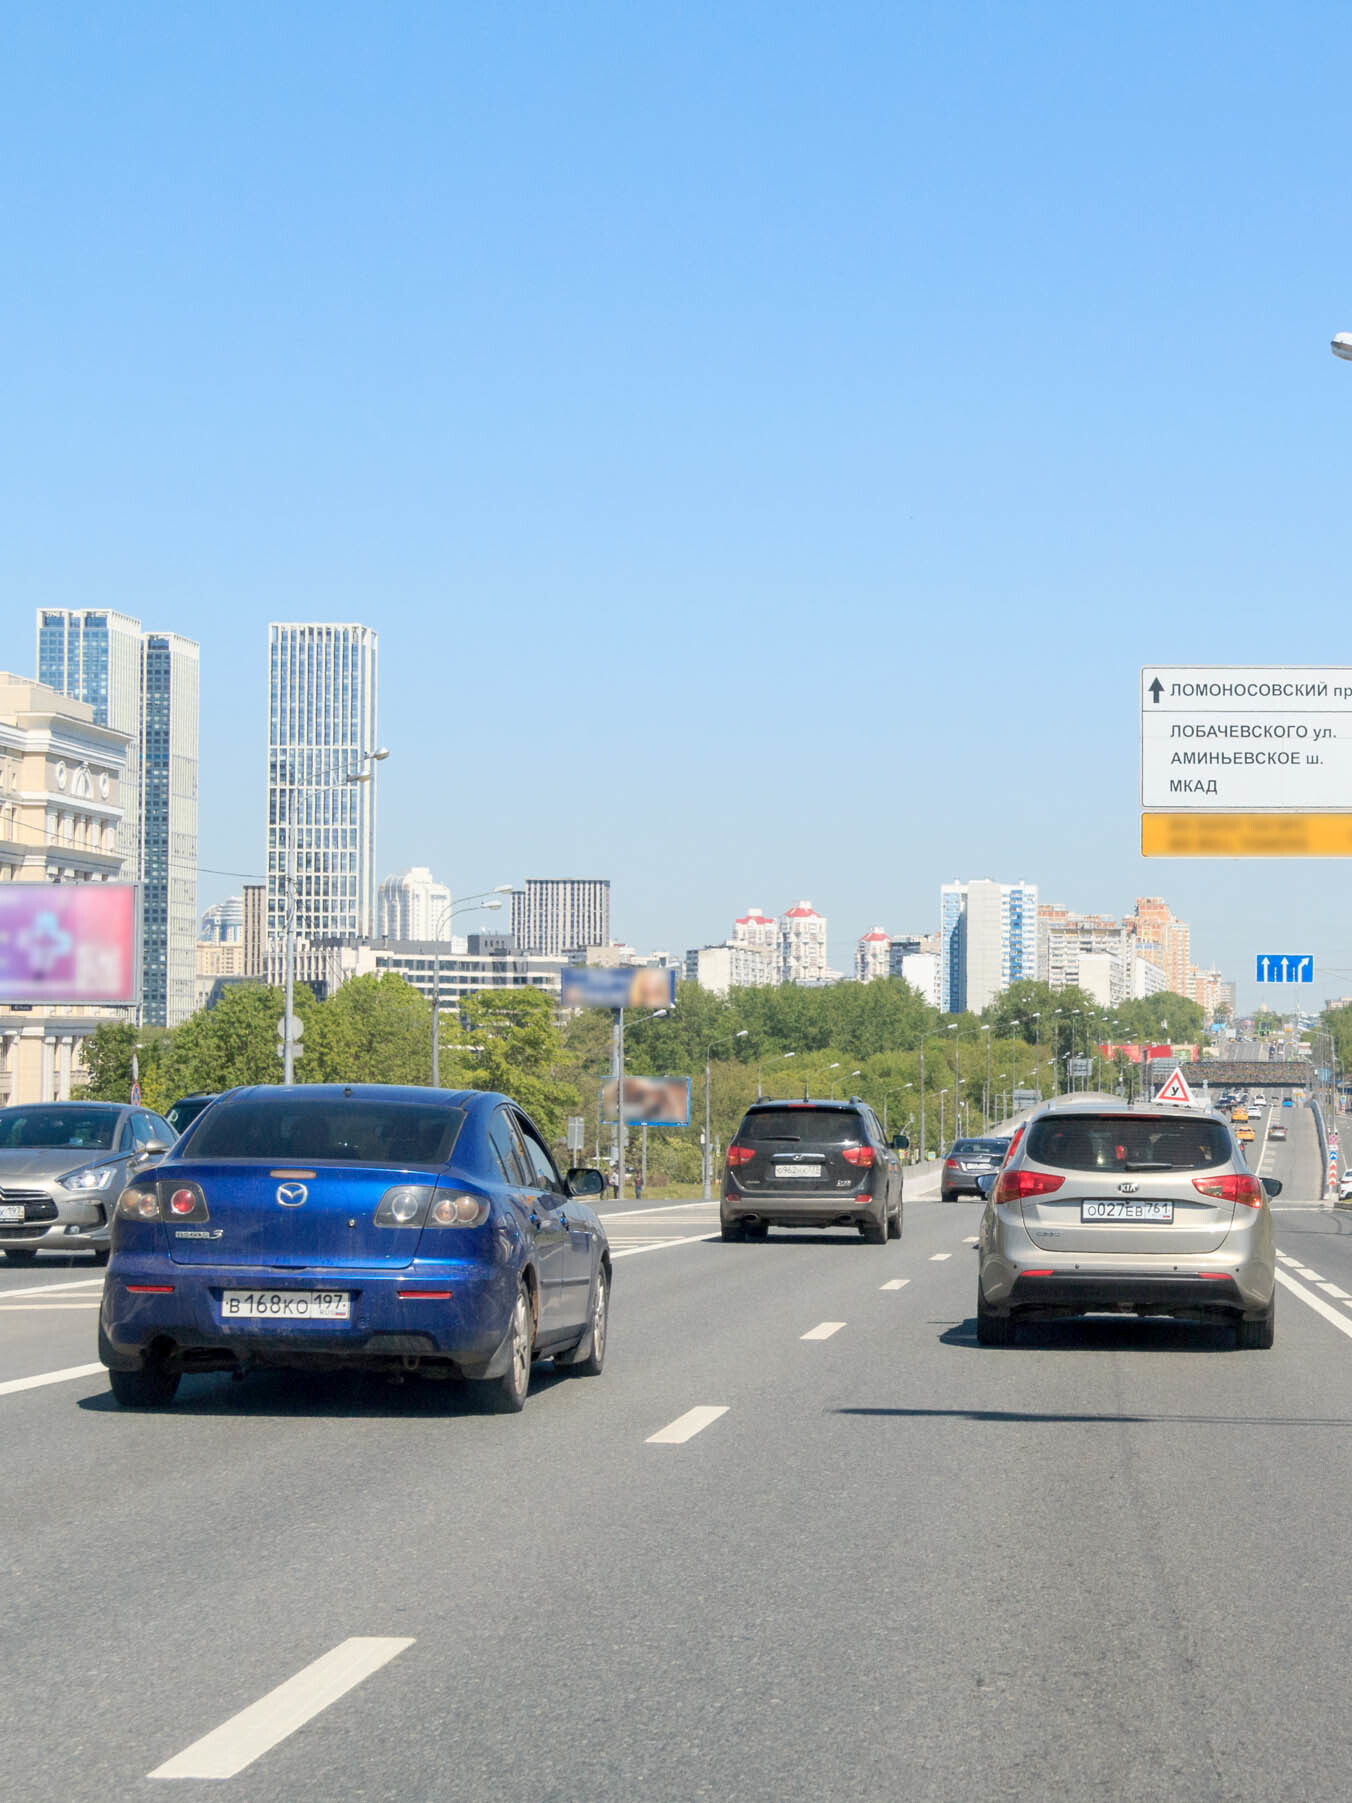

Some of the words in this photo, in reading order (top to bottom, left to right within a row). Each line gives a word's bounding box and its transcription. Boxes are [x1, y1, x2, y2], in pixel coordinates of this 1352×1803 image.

[1170, 681, 1328, 697] ЛОМОНОСОВСКИЙ
[1170, 725, 1308, 738] ЛОБАЧЕВСКОГО
[1313, 727, 1337, 741] ул.
[1170, 752, 1300, 765] АМИНЬЕВСКОЕ
[1306, 754, 1324, 765] ш.
[1170, 780, 1218, 794] МКАД
[1119, 1183, 1137, 1193] KIA
